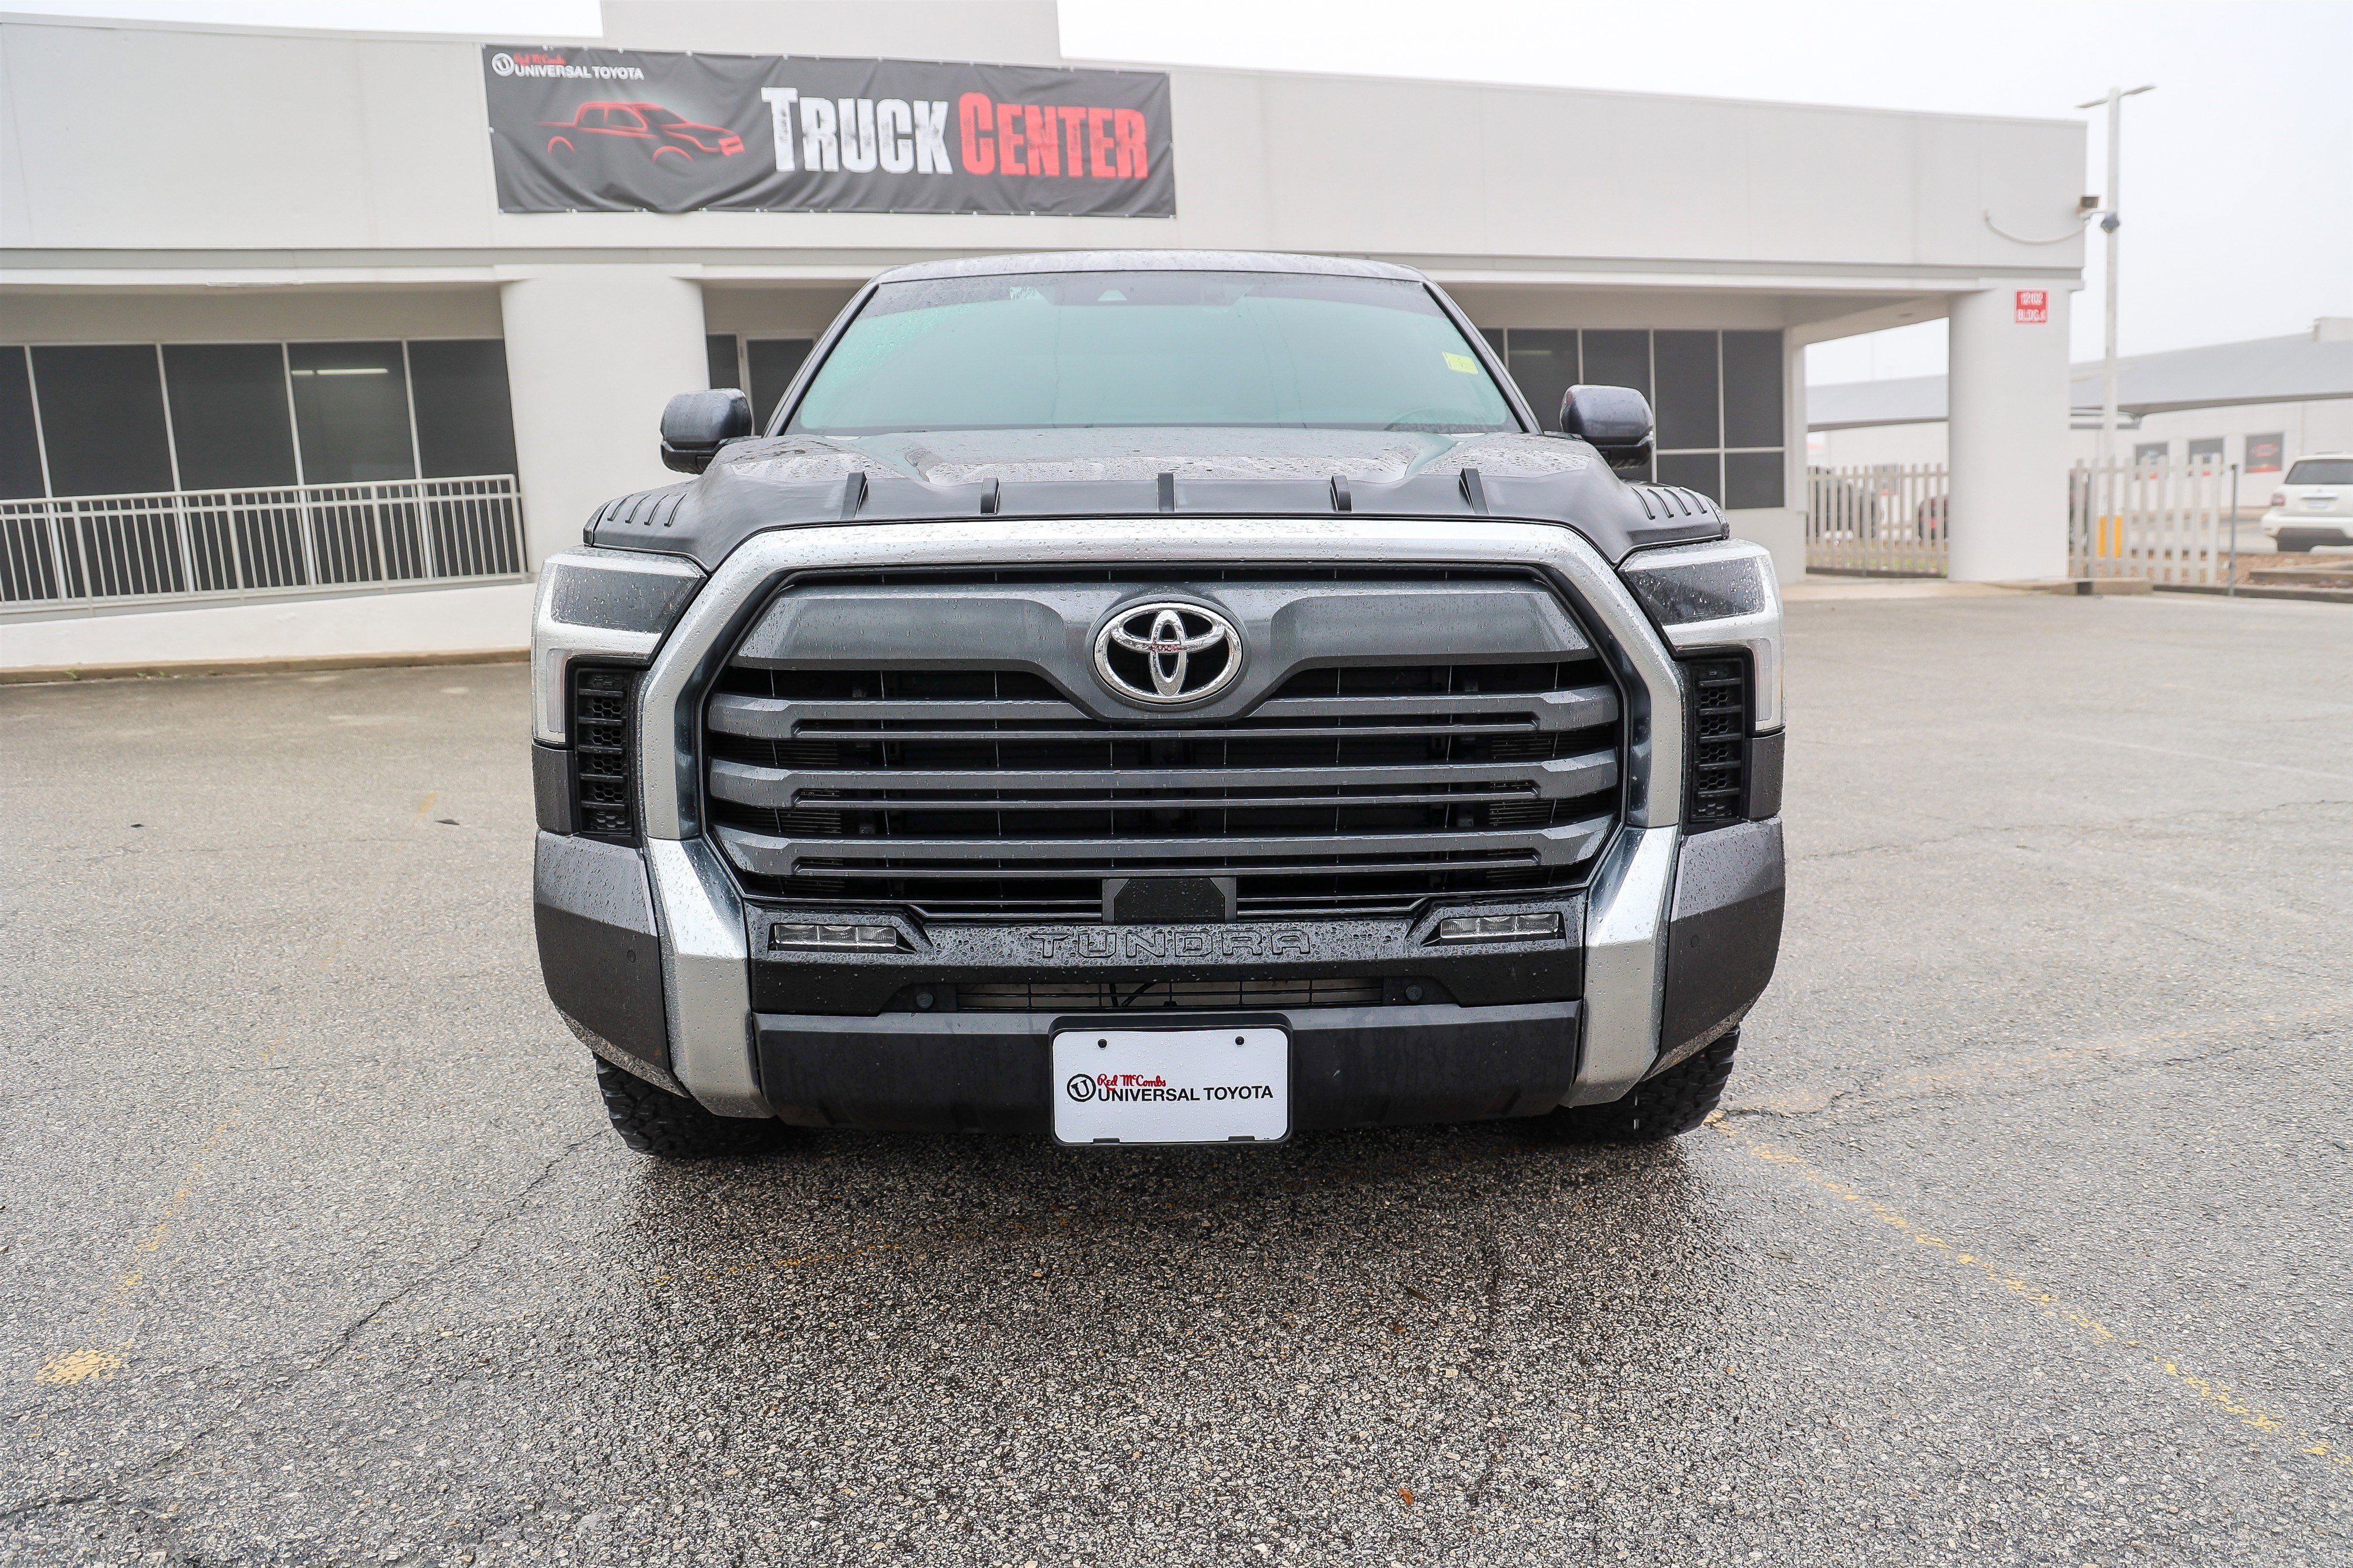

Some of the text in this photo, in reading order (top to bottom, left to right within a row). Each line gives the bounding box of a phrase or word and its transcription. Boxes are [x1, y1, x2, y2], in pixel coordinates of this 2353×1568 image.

[515, 64, 645, 80] UNIVERSAL TOYOTA
[761, 87, 1149, 179] TRUCK CENTER
[1028, 930, 1311, 958] TUNDRA
[1097, 1073, 1167, 1091] Red McCombs
[1098, 1085, 1274, 1102] UNIVERSAL TOYOTA
